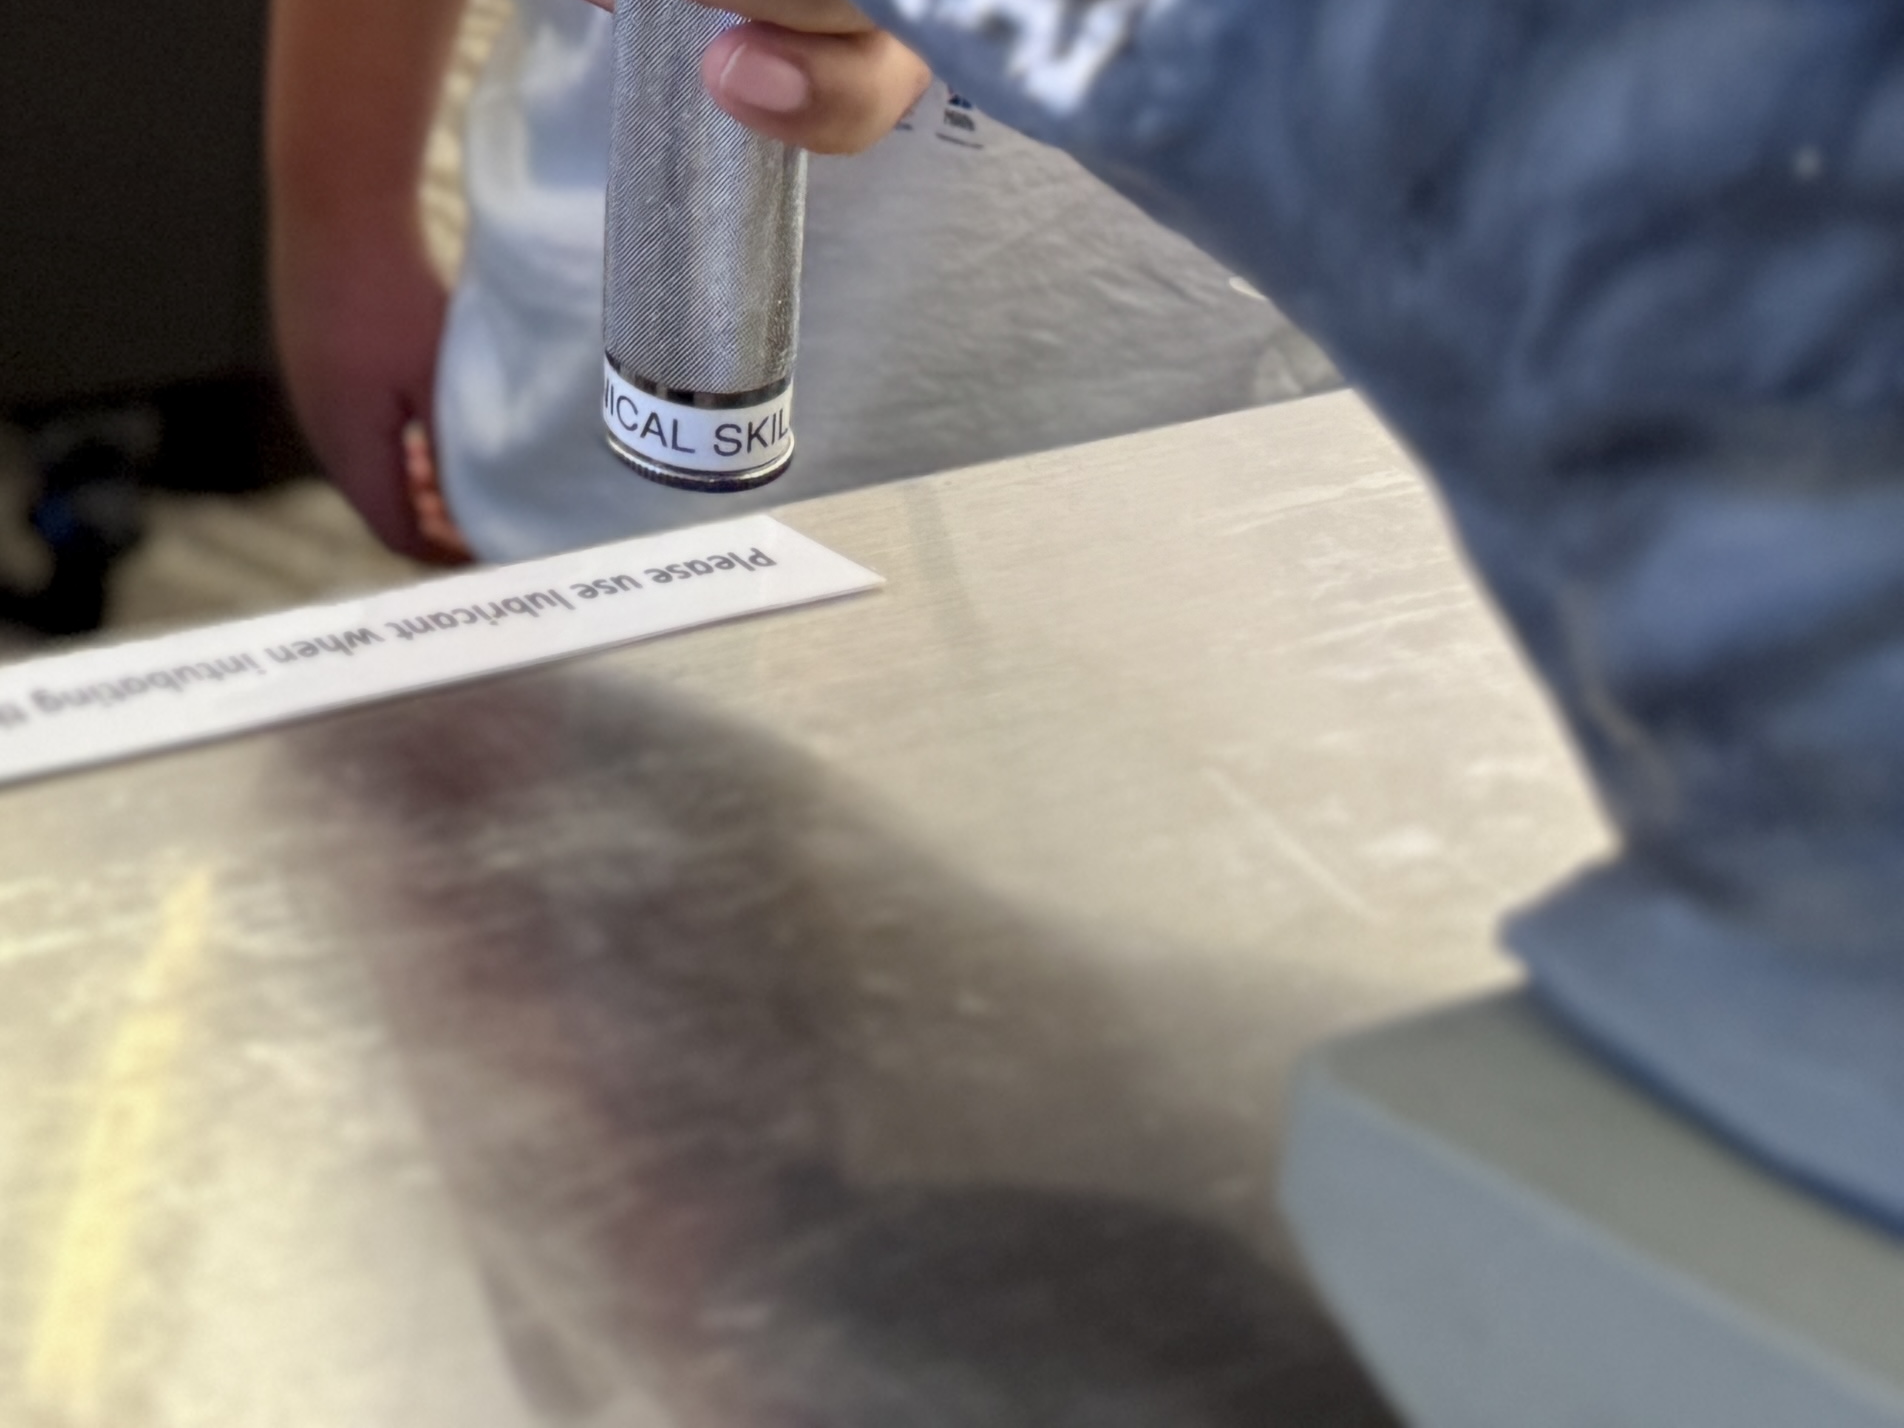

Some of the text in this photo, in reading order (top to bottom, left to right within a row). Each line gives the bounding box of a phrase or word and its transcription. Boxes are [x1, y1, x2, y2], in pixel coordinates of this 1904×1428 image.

[645, 546, 778, 584] Please
[573, 573, 642, 600] use
[385, 587, 577, 640] lubricant
[270, 625, 384, 664] when
[31, 650, 267, 715] intubating
